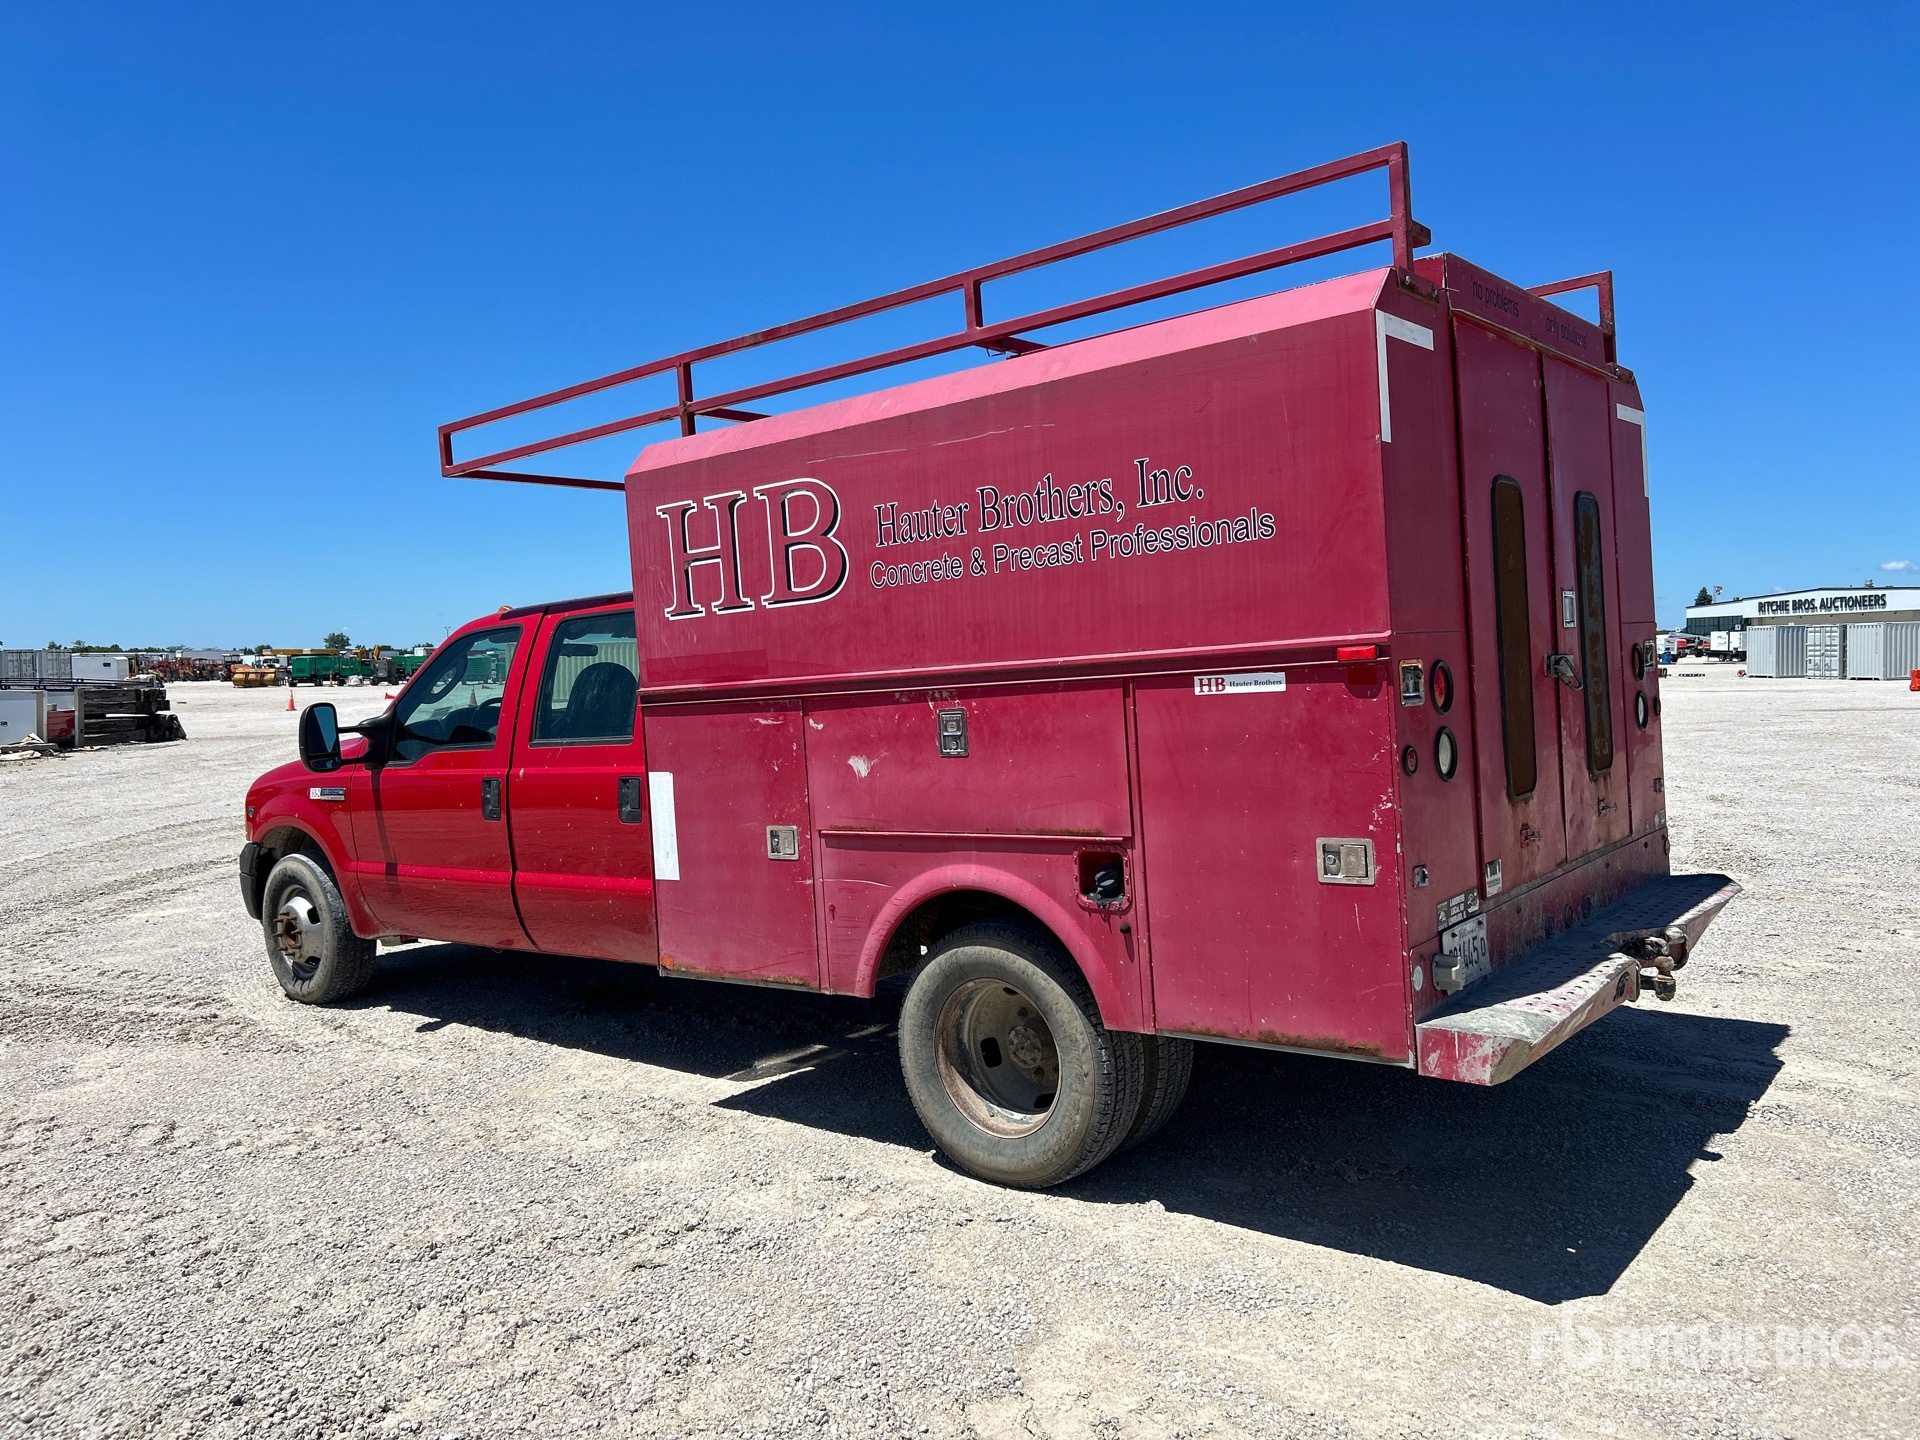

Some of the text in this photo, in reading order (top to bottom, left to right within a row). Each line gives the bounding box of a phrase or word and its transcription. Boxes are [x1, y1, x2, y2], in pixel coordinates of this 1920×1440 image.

[1485, 287, 1519, 317] problems
[874, 457, 1204, 547] Hauter Brothers, Inc.
[656, 478, 849, 620] HB
[870, 507, 1276, 588] Concrete & Precast Professionals
[1758, 594, 1887, 613] RITCHIE BROS. AUCTIONEERS
[1198, 677, 1226, 693] HB
